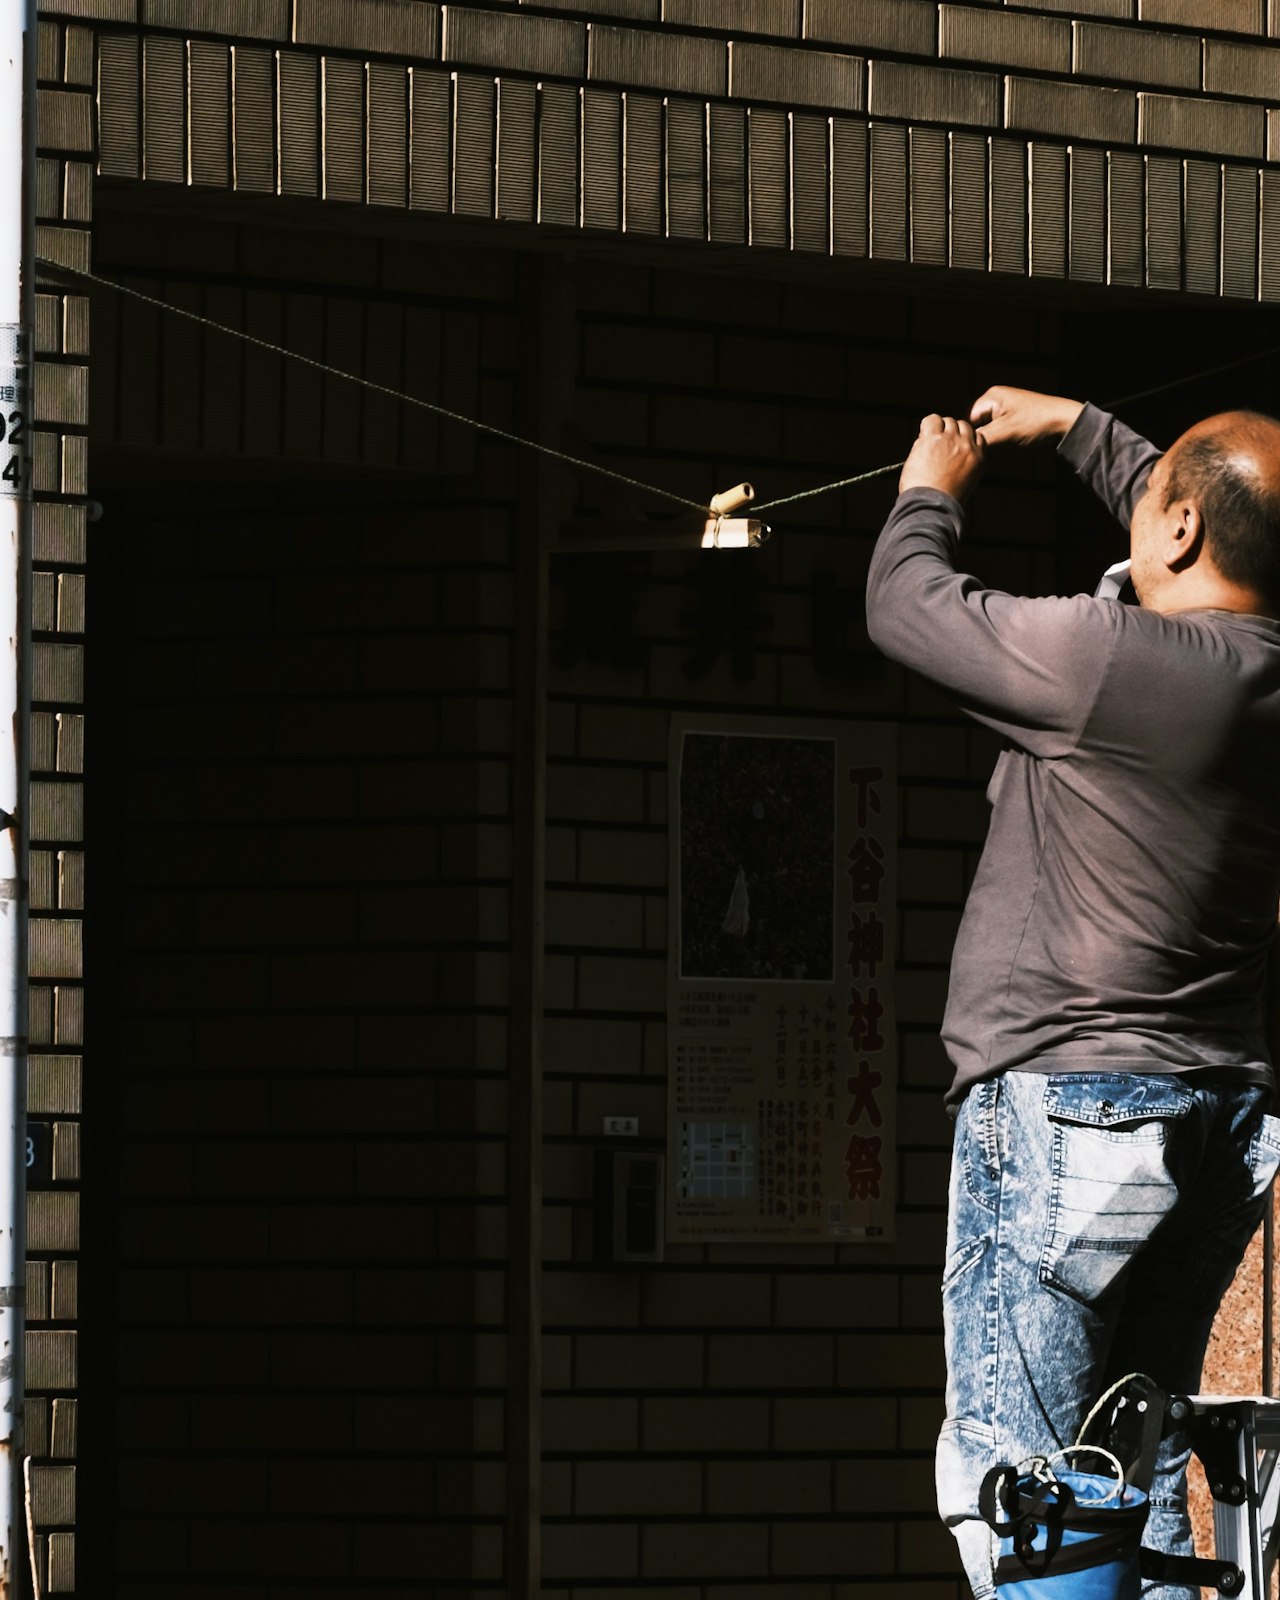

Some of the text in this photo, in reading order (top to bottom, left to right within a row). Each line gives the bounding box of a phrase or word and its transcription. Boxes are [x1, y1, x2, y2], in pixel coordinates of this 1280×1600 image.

[846, 765, 885, 1202] 下谷神社大祭
